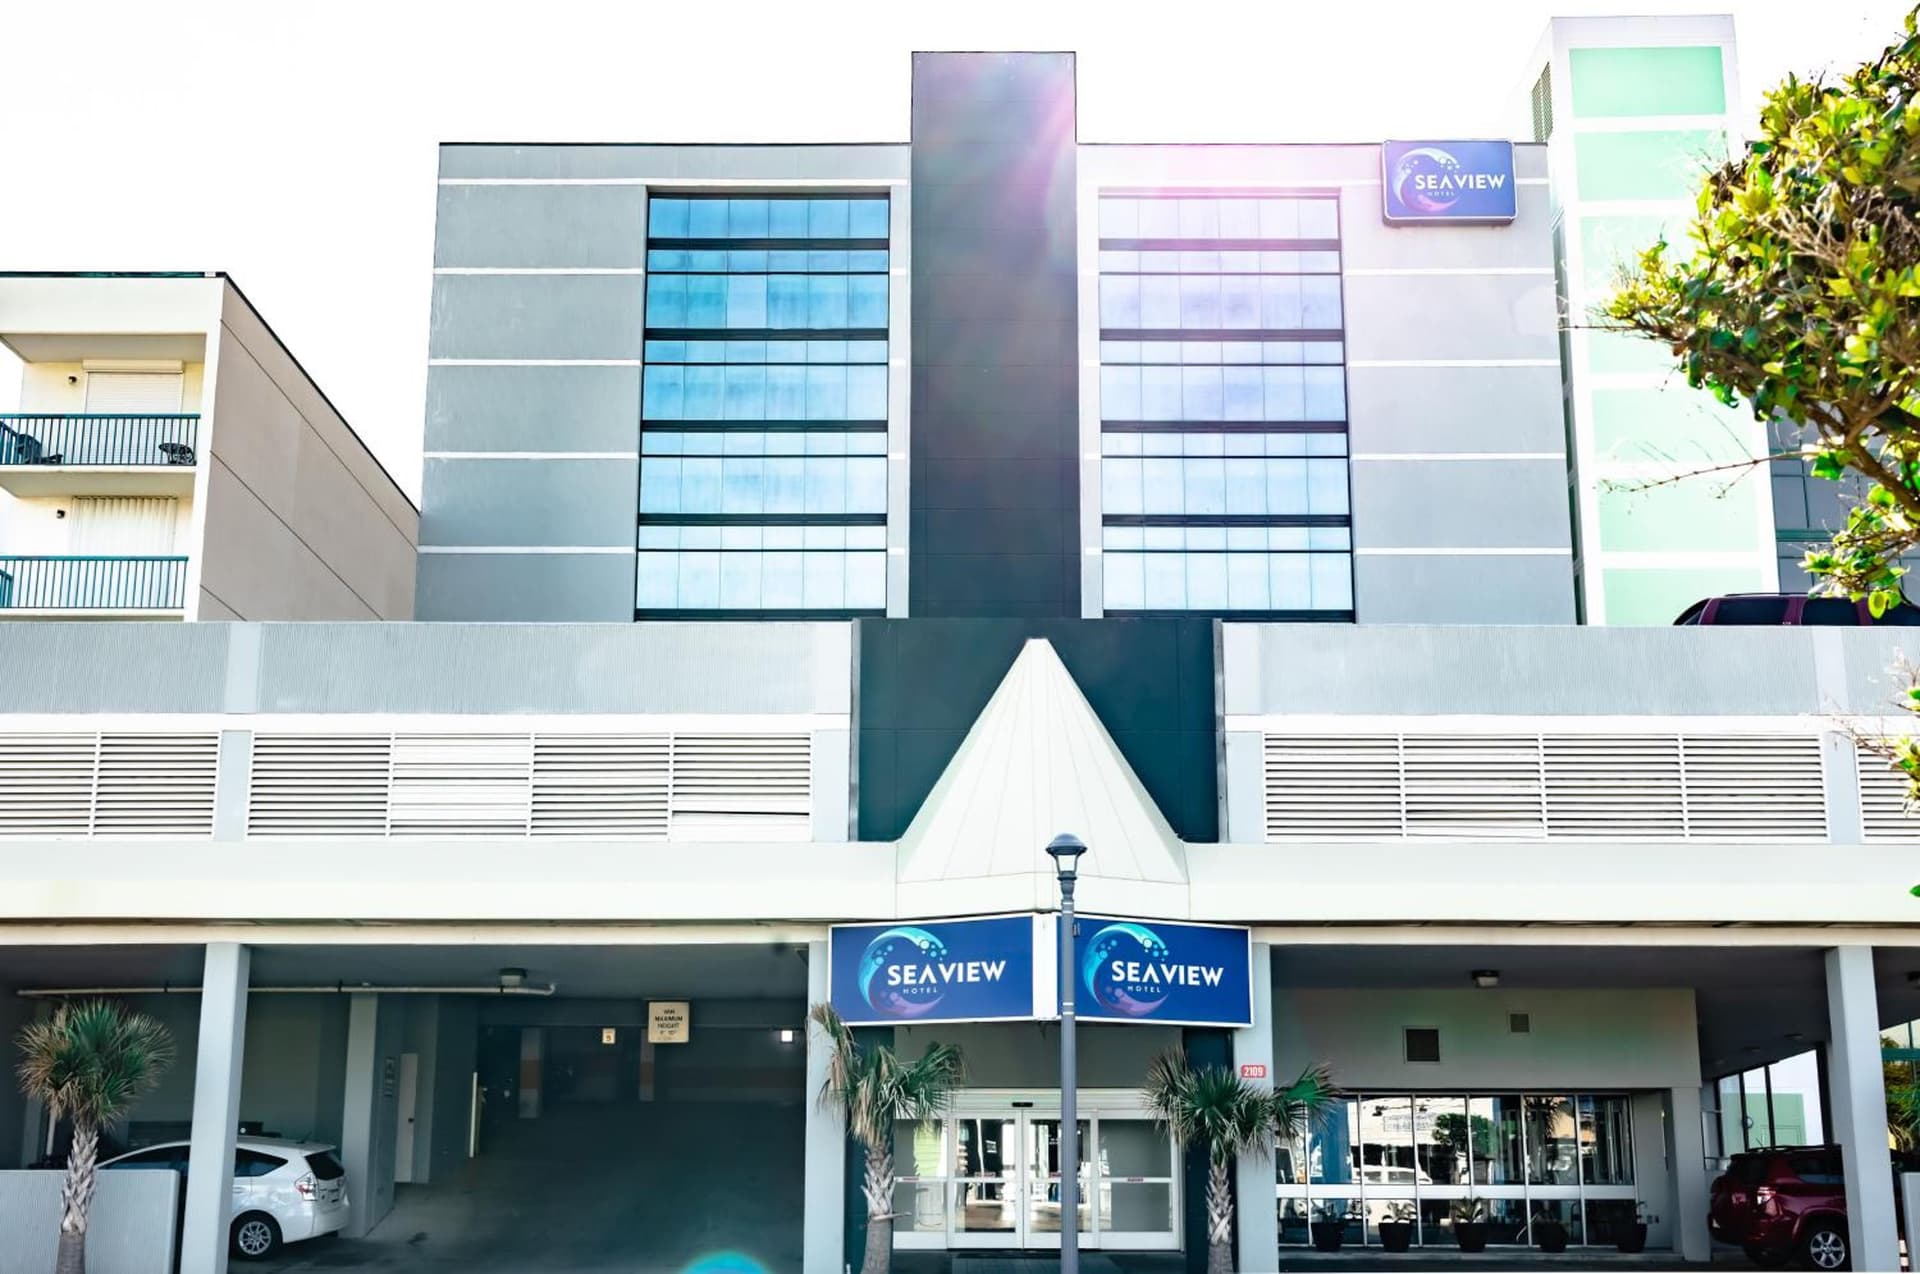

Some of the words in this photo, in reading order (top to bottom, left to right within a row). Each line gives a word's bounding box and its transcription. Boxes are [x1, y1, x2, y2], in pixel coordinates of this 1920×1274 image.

[1414, 174, 1506, 190] SEAVIEW
[887, 960, 1007, 986] SEAVIEW
[1111, 960, 1225, 988] SEAVIEW
[902, 986, 939, 995] HOTEL
[1126, 985, 1162, 994] HOTEL
